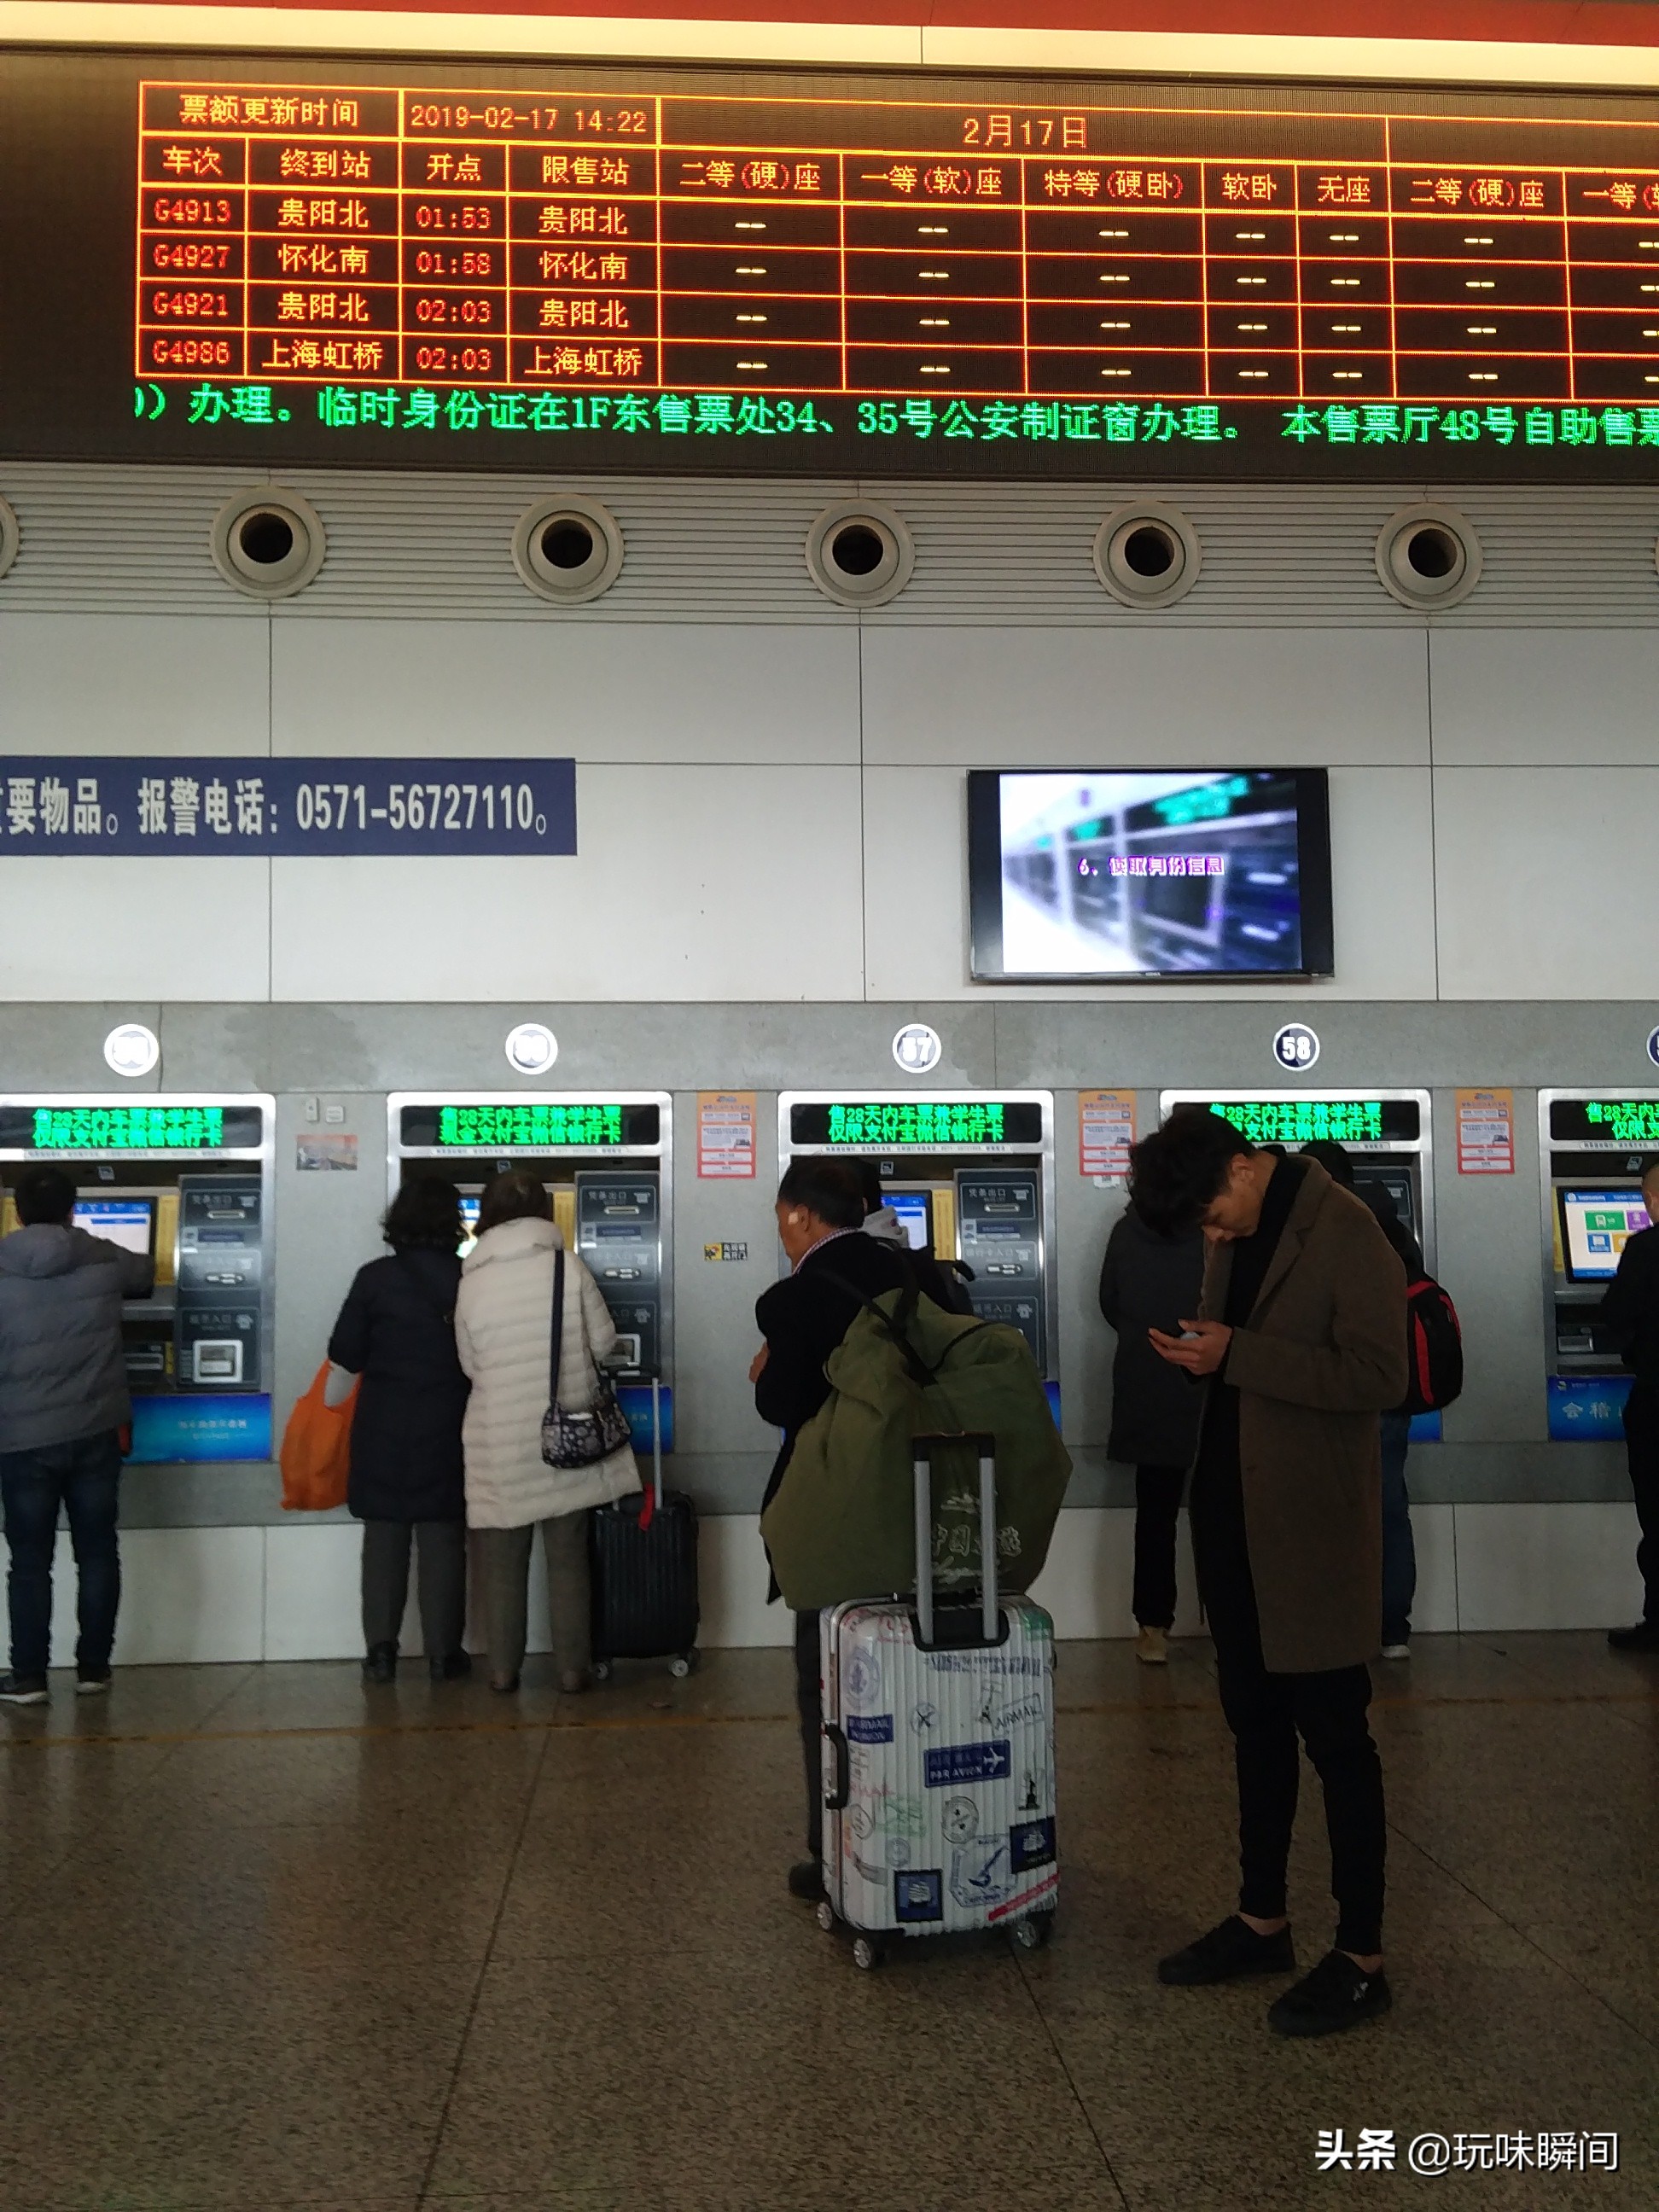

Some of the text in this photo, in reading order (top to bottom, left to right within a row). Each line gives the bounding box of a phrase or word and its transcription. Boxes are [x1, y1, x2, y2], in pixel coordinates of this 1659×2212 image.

[178, 94, 358, 128] 票额更新时间
[409, 104, 648, 134] 2019-02-17 14:22
[962, 114, 1089, 148] 2月17日
[162, 145, 223, 177] 车次
[279, 148, 371, 179] 终到站
[427, 152, 482, 182] 开点
[542, 154, 630, 186] 限售站
[1222, 172, 1278, 201] 软卧
[1318, 175, 1371, 204] 无座
[154, 197, 231, 224] G4913
[277, 197, 370, 229] 贵阳北
[416, 205, 492, 230] 01:53
[538, 205, 629, 236] 贵阳北
[154, 243, 230, 270] G4927
[277, 243, 370, 274] 怀化南
[416, 251, 492, 276] 01:58
[538, 251, 629, 281] 怀化南
[153, 291, 229, 317] G4921
[277, 291, 370, 323] 贵阳北
[416, 299, 492, 324] 02:03
[539, 299, 630, 329] 贵阳北
[153, 339, 231, 365] G4986
[261, 339, 384, 370] 上海虹桥
[416, 346, 492, 371] 02:03
[524, 346, 643, 376] 上海虹桥
[0, 777, 546, 835] 要物品。报警电话：0571-56727110。
[1282, 1036, 1311, 1061] 58
